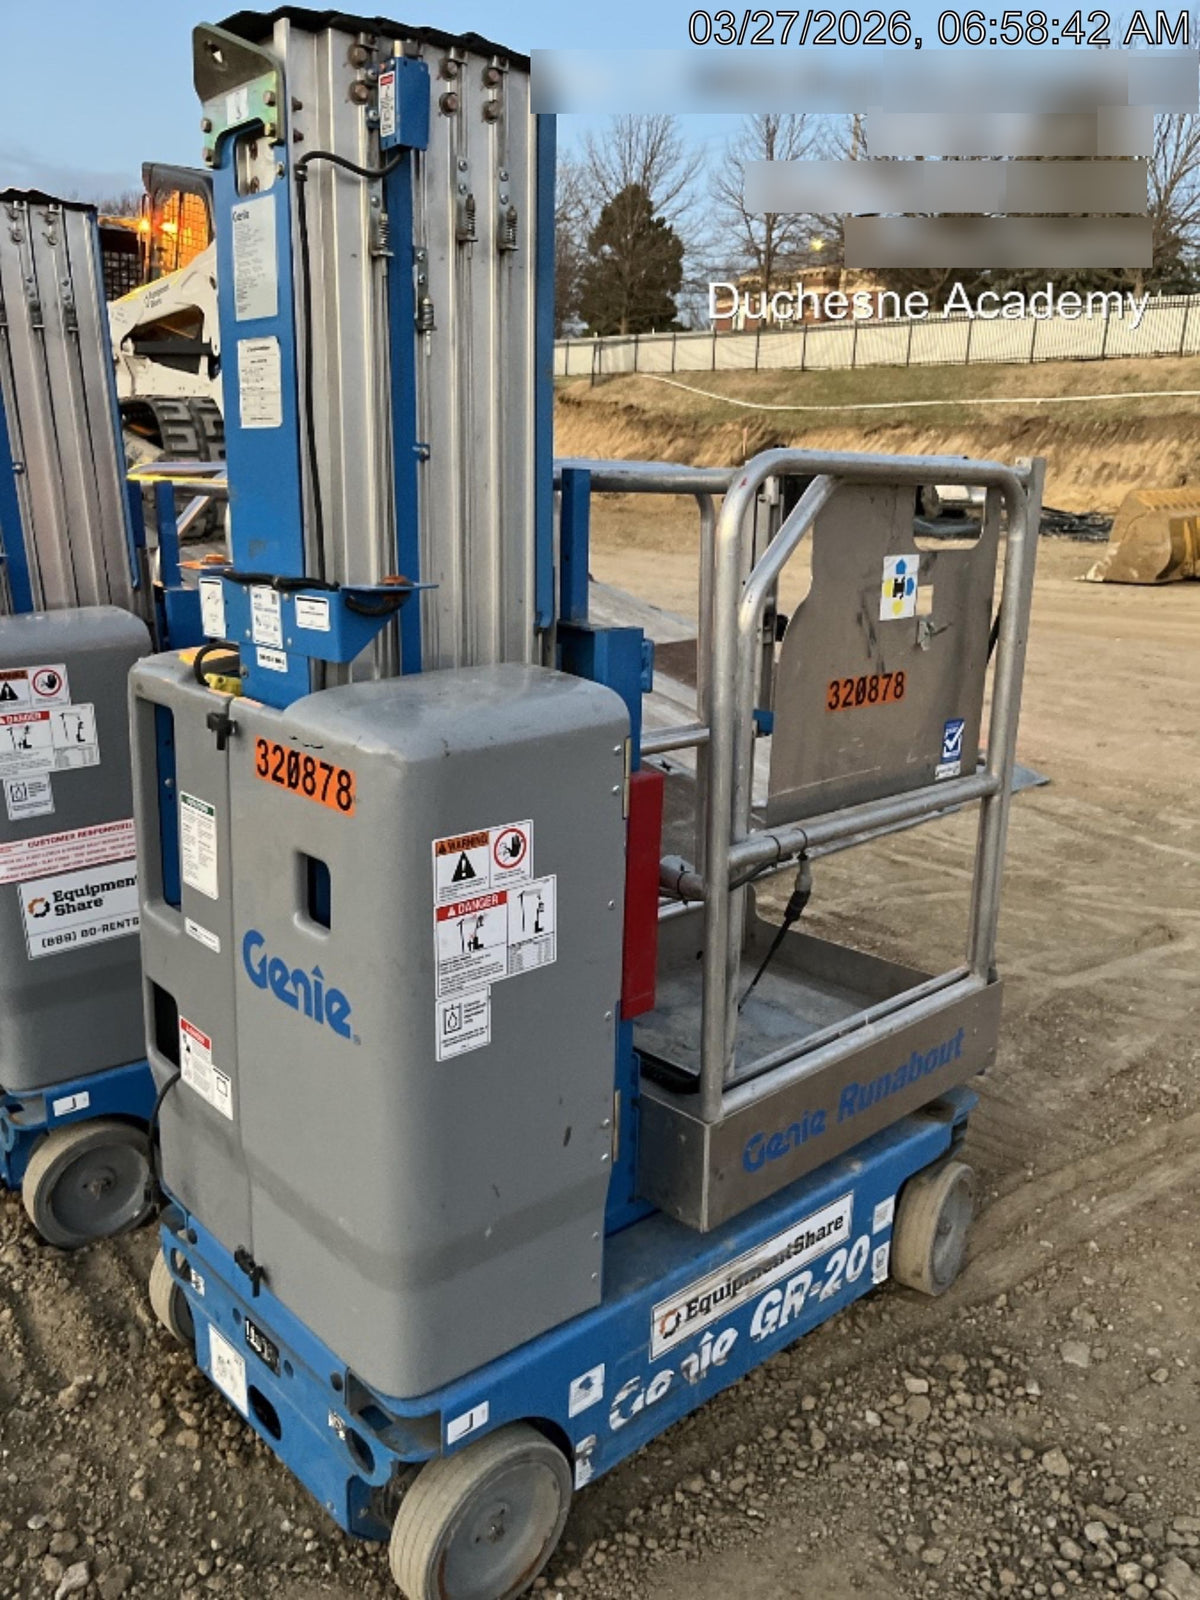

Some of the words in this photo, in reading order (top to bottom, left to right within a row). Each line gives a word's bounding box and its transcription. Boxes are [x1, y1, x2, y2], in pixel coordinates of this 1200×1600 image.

[828, 671, 905, 710] 320878
[256, 738, 352, 812] 320878
[52, 875, 137, 904] Equipmen
[54, 897, 104, 917] Share
[458, 894, 499, 914] DANGER
[243, 929, 351, 1039] Genie
[741, 1108, 827, 1174] Genie
[838, 1027, 965, 1124] Runabout
[750, 1234, 871, 1343] GR-20
